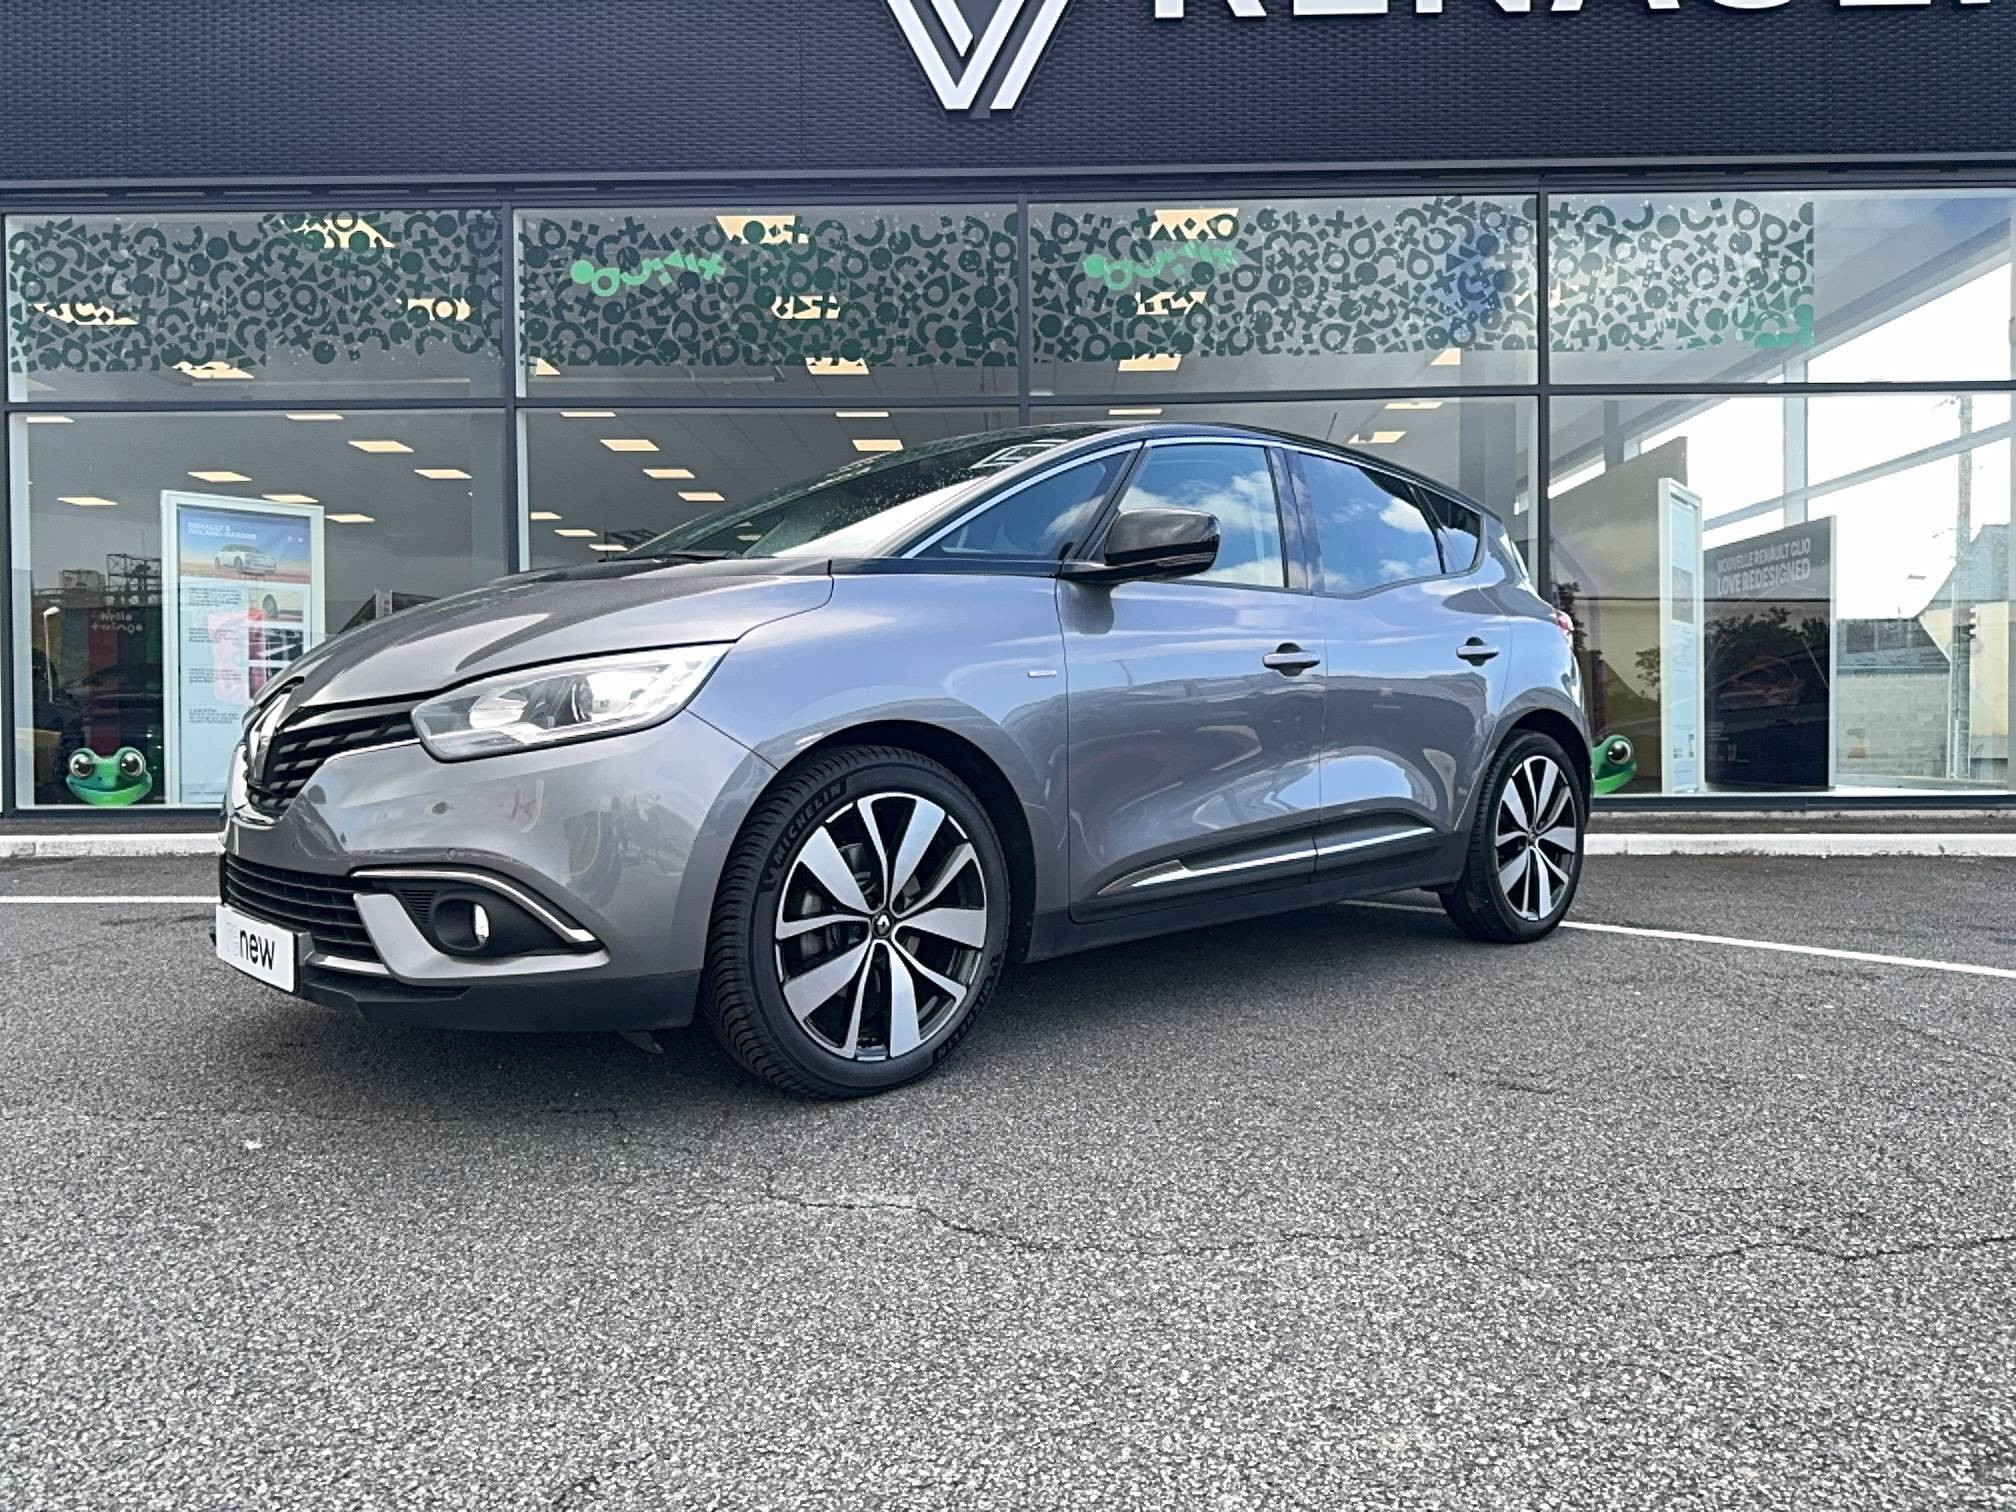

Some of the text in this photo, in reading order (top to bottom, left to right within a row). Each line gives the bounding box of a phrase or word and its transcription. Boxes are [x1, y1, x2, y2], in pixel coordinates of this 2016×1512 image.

[1718, 558, 1811, 597] LOVE REDESIGNED
[772, 782, 841, 866] MICHELIN
